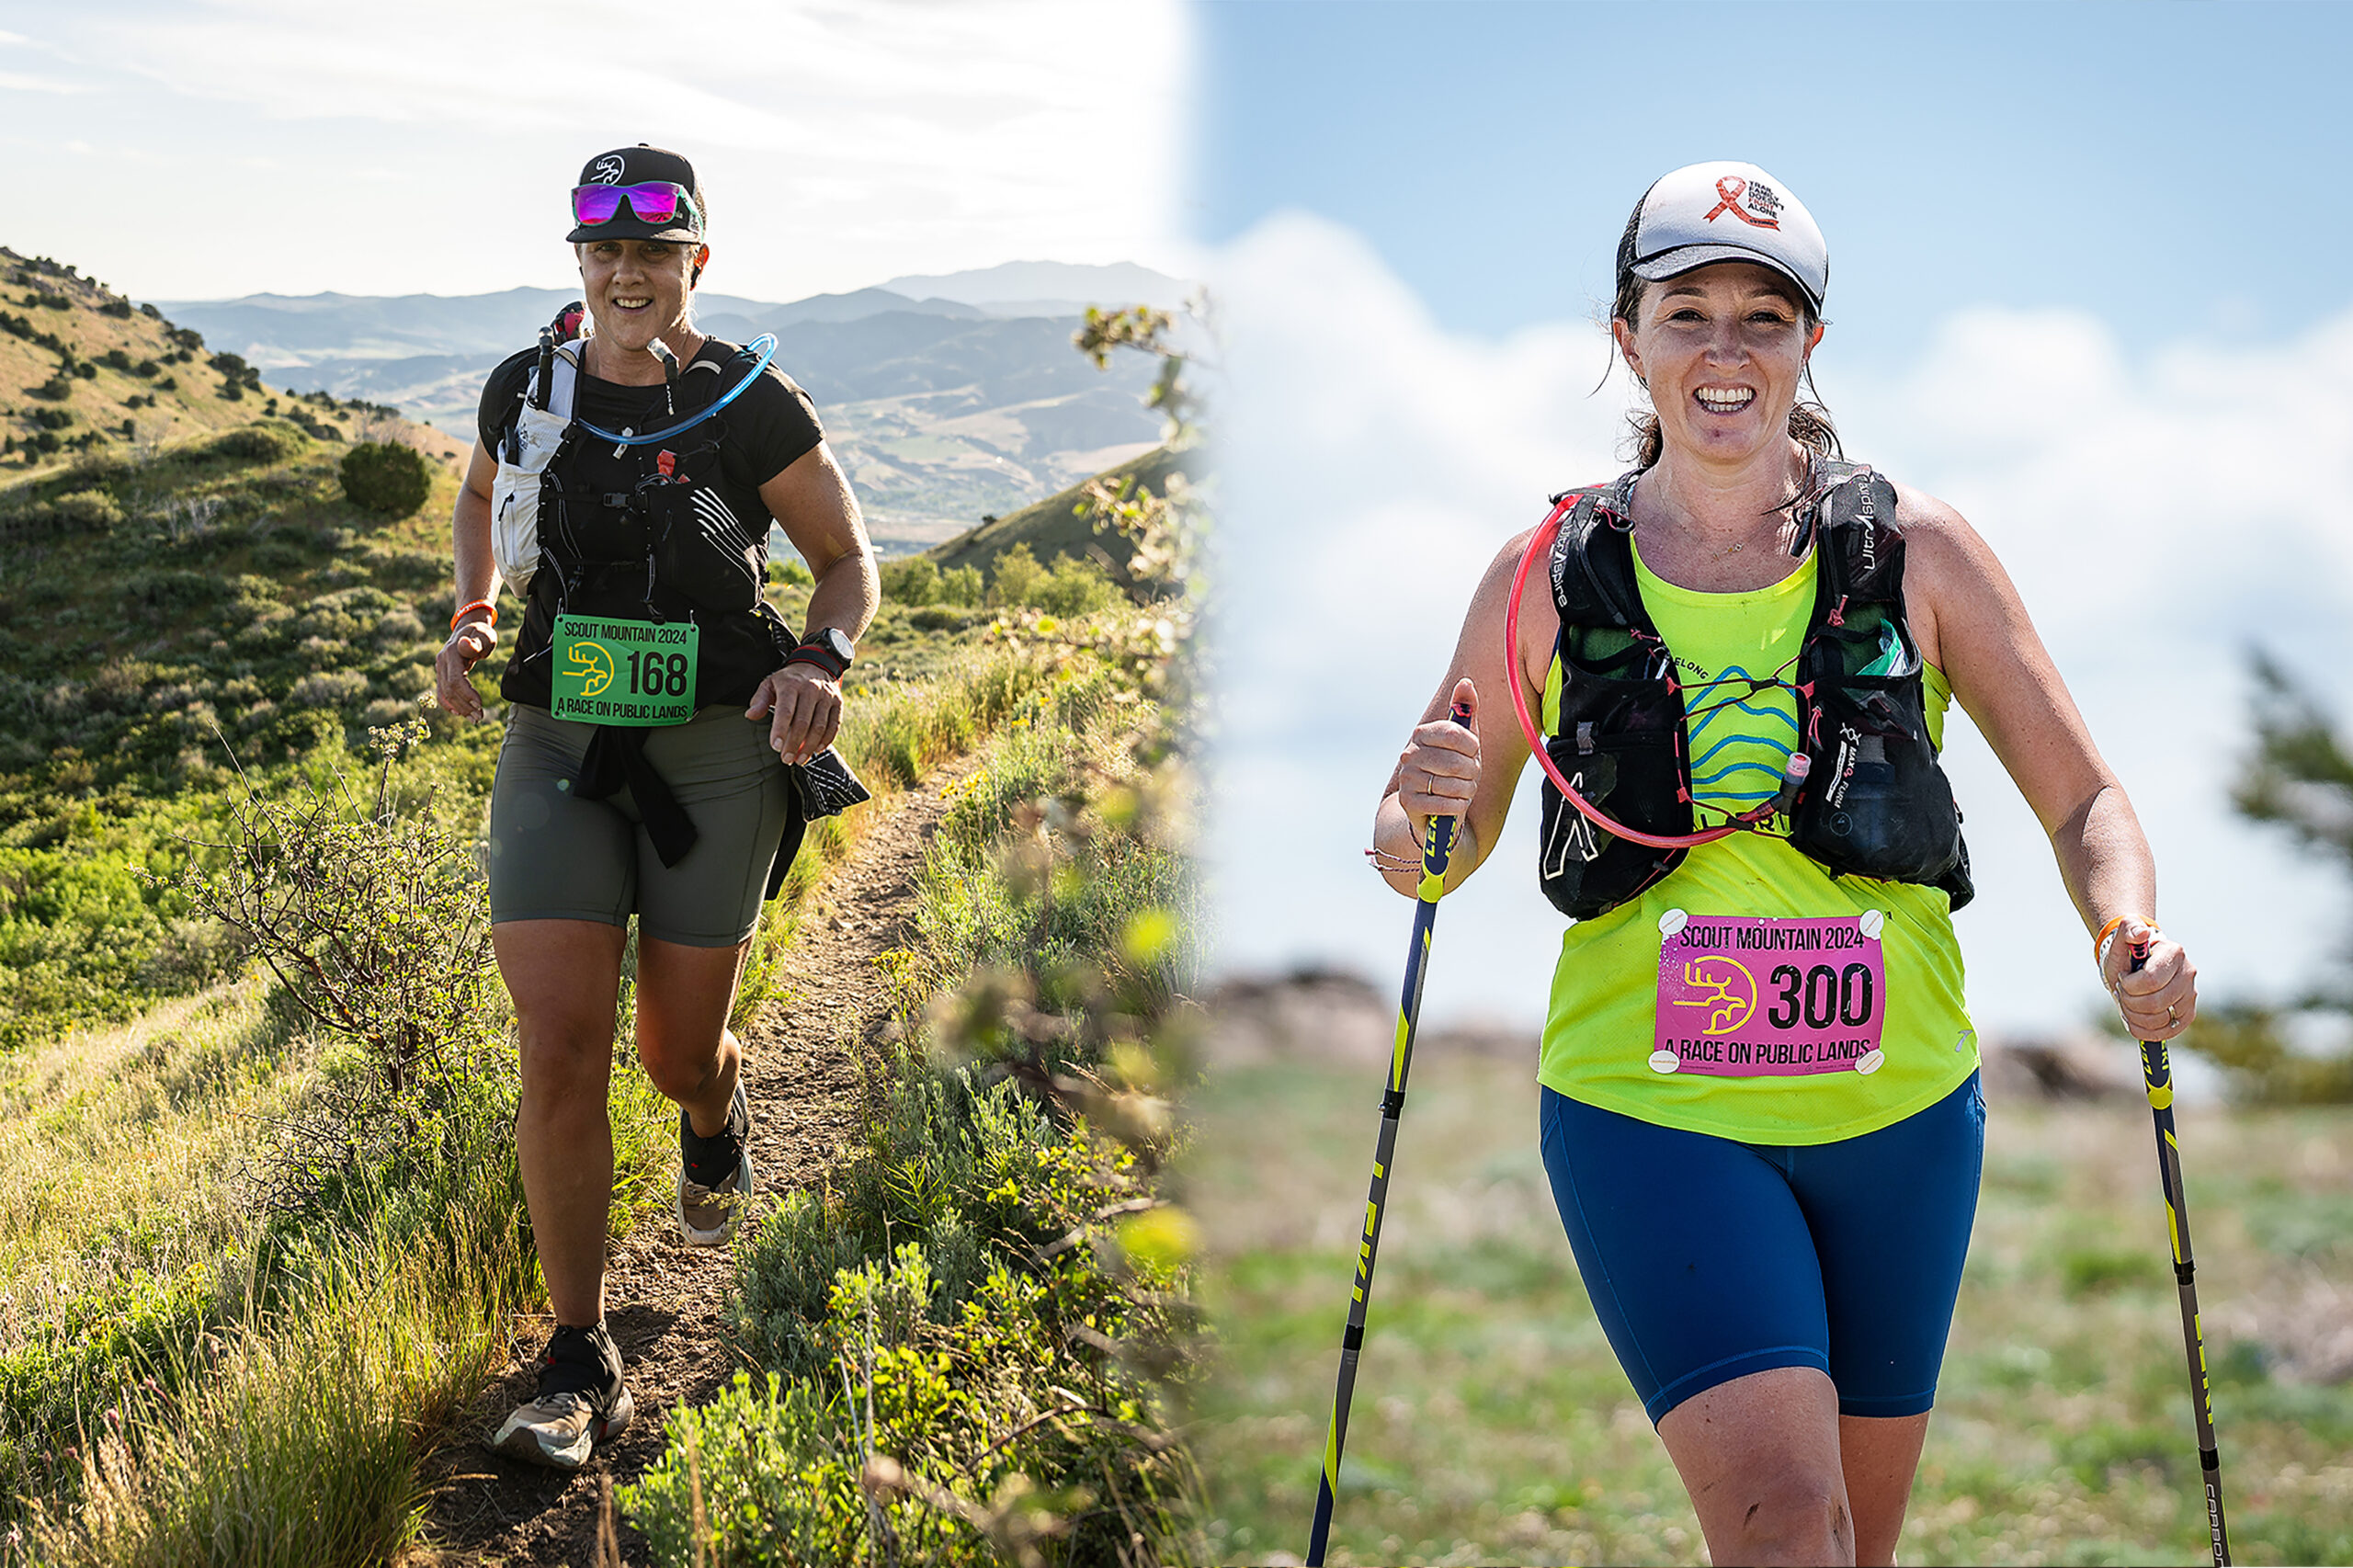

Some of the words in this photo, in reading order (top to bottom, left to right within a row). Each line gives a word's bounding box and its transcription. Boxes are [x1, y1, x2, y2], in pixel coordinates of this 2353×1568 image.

[1747, 202, 1778, 220] ALONE
[564, 621, 599, 639] SCOUT
[600, 625, 656, 643] MOUNTAIN
[657, 629, 688, 645] 2024
[627, 651, 688, 698] 168
[557, 697, 565, 712] A
[566, 698, 595, 715] RACE
[597, 700, 611, 717] ON
[612, 702, 651, 720] PUBLIC
[652, 704, 688, 720] LANDS
[1679, 926, 1733, 949] SCOUT
[1736, 927, 1822, 950] MOUNTAIN
[1824, 926, 1865, 949] 2024
[1768, 962, 1874, 1030] 300
[1678, 1039, 1724, 1063] RACE
[1728, 1041, 1752, 1064] ON
[1756, 1043, 1814, 1065] PUBLIC
[1816, 1039, 1871, 1062] LANDS
